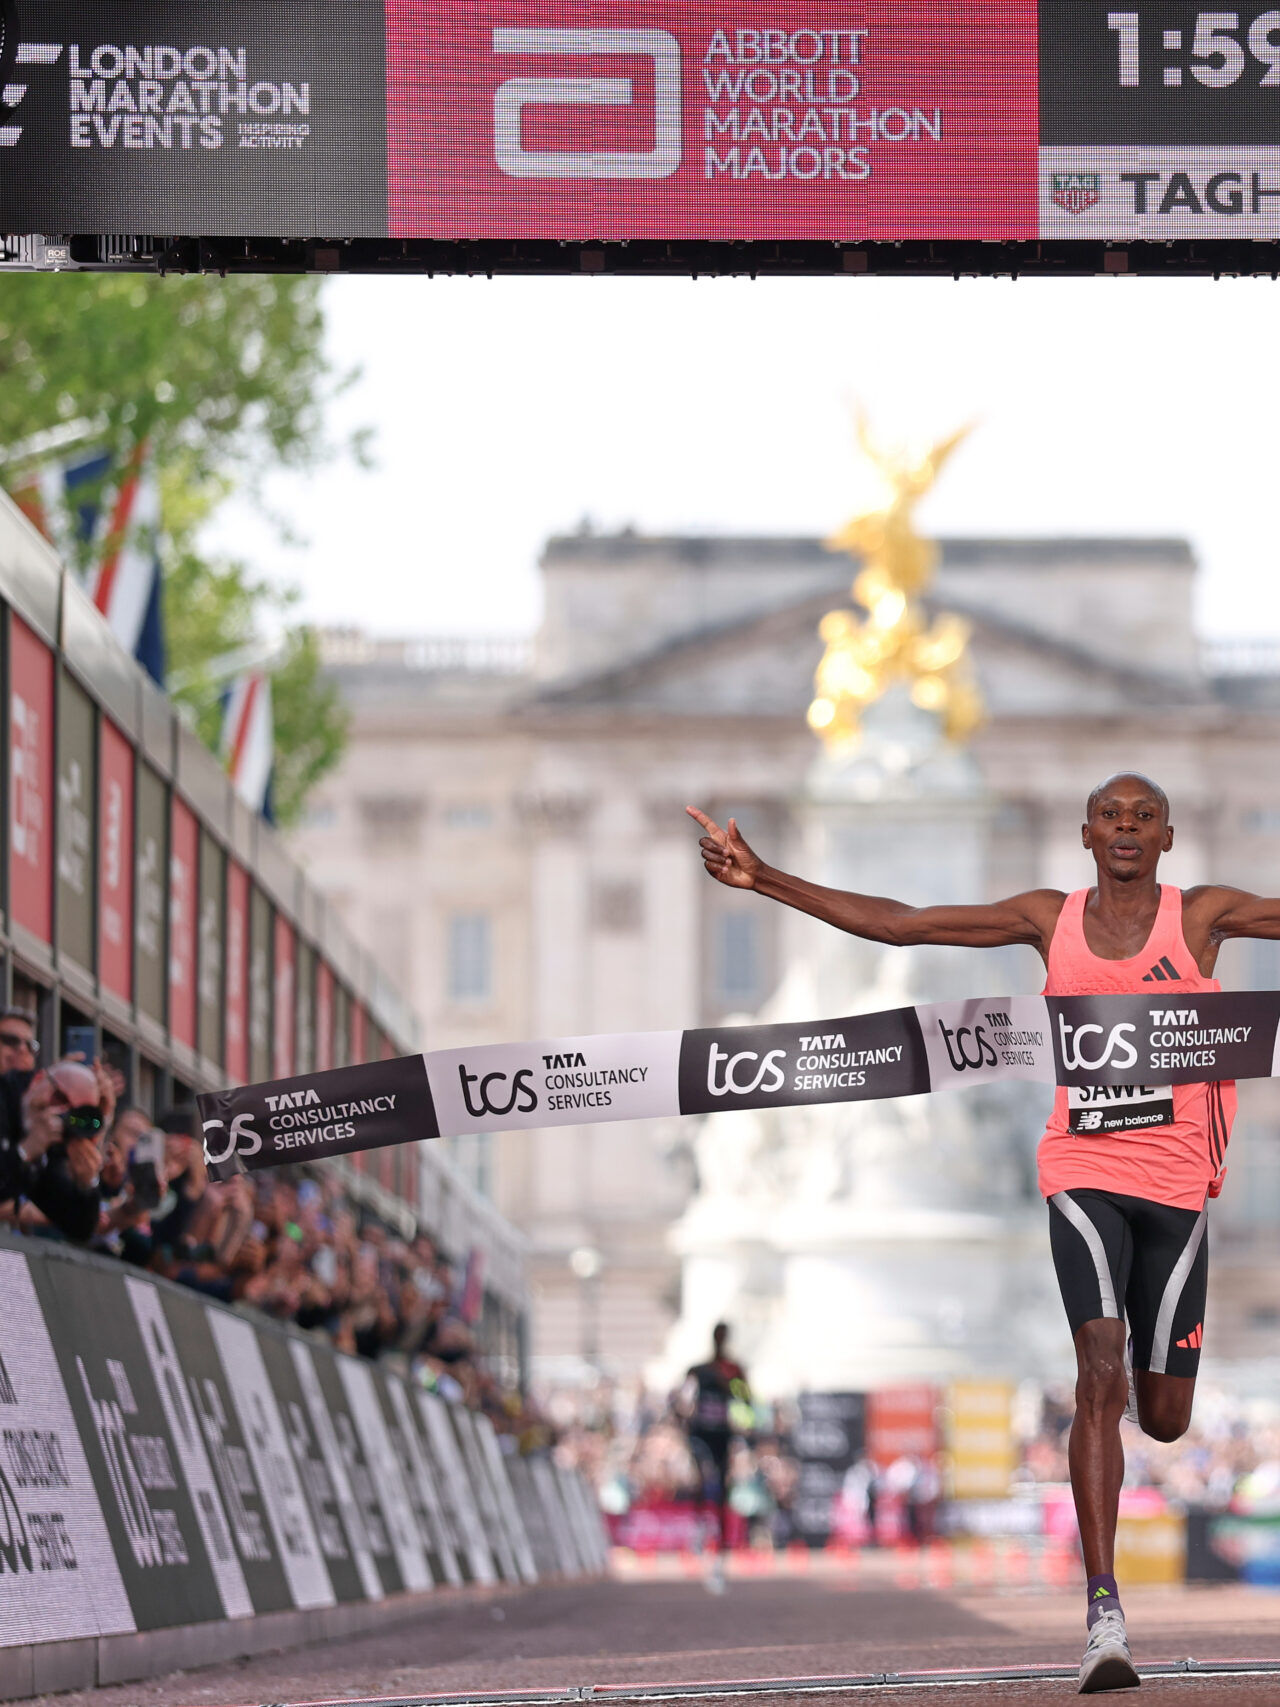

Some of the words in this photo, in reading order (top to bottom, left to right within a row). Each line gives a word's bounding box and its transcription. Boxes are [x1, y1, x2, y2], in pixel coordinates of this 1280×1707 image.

[703, 29, 870, 64] ABBOTT
[69, 43, 247, 80] LONDON
[69, 79, 310, 114] MARATHON
[702, 68, 860, 103] WORLD
[69, 114, 224, 149] EVENTS
[704, 107, 942, 141] MARATHON
[238, 136, 305, 148] ACTIVITY
[704, 146, 872, 180] MAJORS
[984, 1012, 1012, 1028] TATA
[1149, 1009, 1199, 1026] TATA
[799, 1033, 846, 1051] TATA
[938, 1018, 998, 1072] tcs
[993, 1031, 1044, 1047] CONSULTANCY
[1058, 1012, 1136, 1071] tcs
[1149, 1026, 1252, 1048] CONSULTANCY
[542, 1052, 586, 1069] TATA
[707, 1042, 787, 1096] tcs
[796, 1045, 903, 1072] CONSULTANCY
[1001, 1050, 1035, 1066] SERVICES
[1149, 1050, 1216, 1069] SERVICES
[458, 1064, 538, 1117] tcs
[545, 1067, 648, 1090] CONSULTANCY
[793, 1071, 866, 1090] SERVICES
[264, 1089, 322, 1112] TATA
[269, 1095, 397, 1130] CONSULTANCY
[547, 1091, 612, 1110] SERVICES
[1104, 1119, 1124, 1128] new
[1124, 1113, 1164, 1126] balance
[202, 1113, 262, 1165] cs
[273, 1123, 356, 1150] SERVICES
